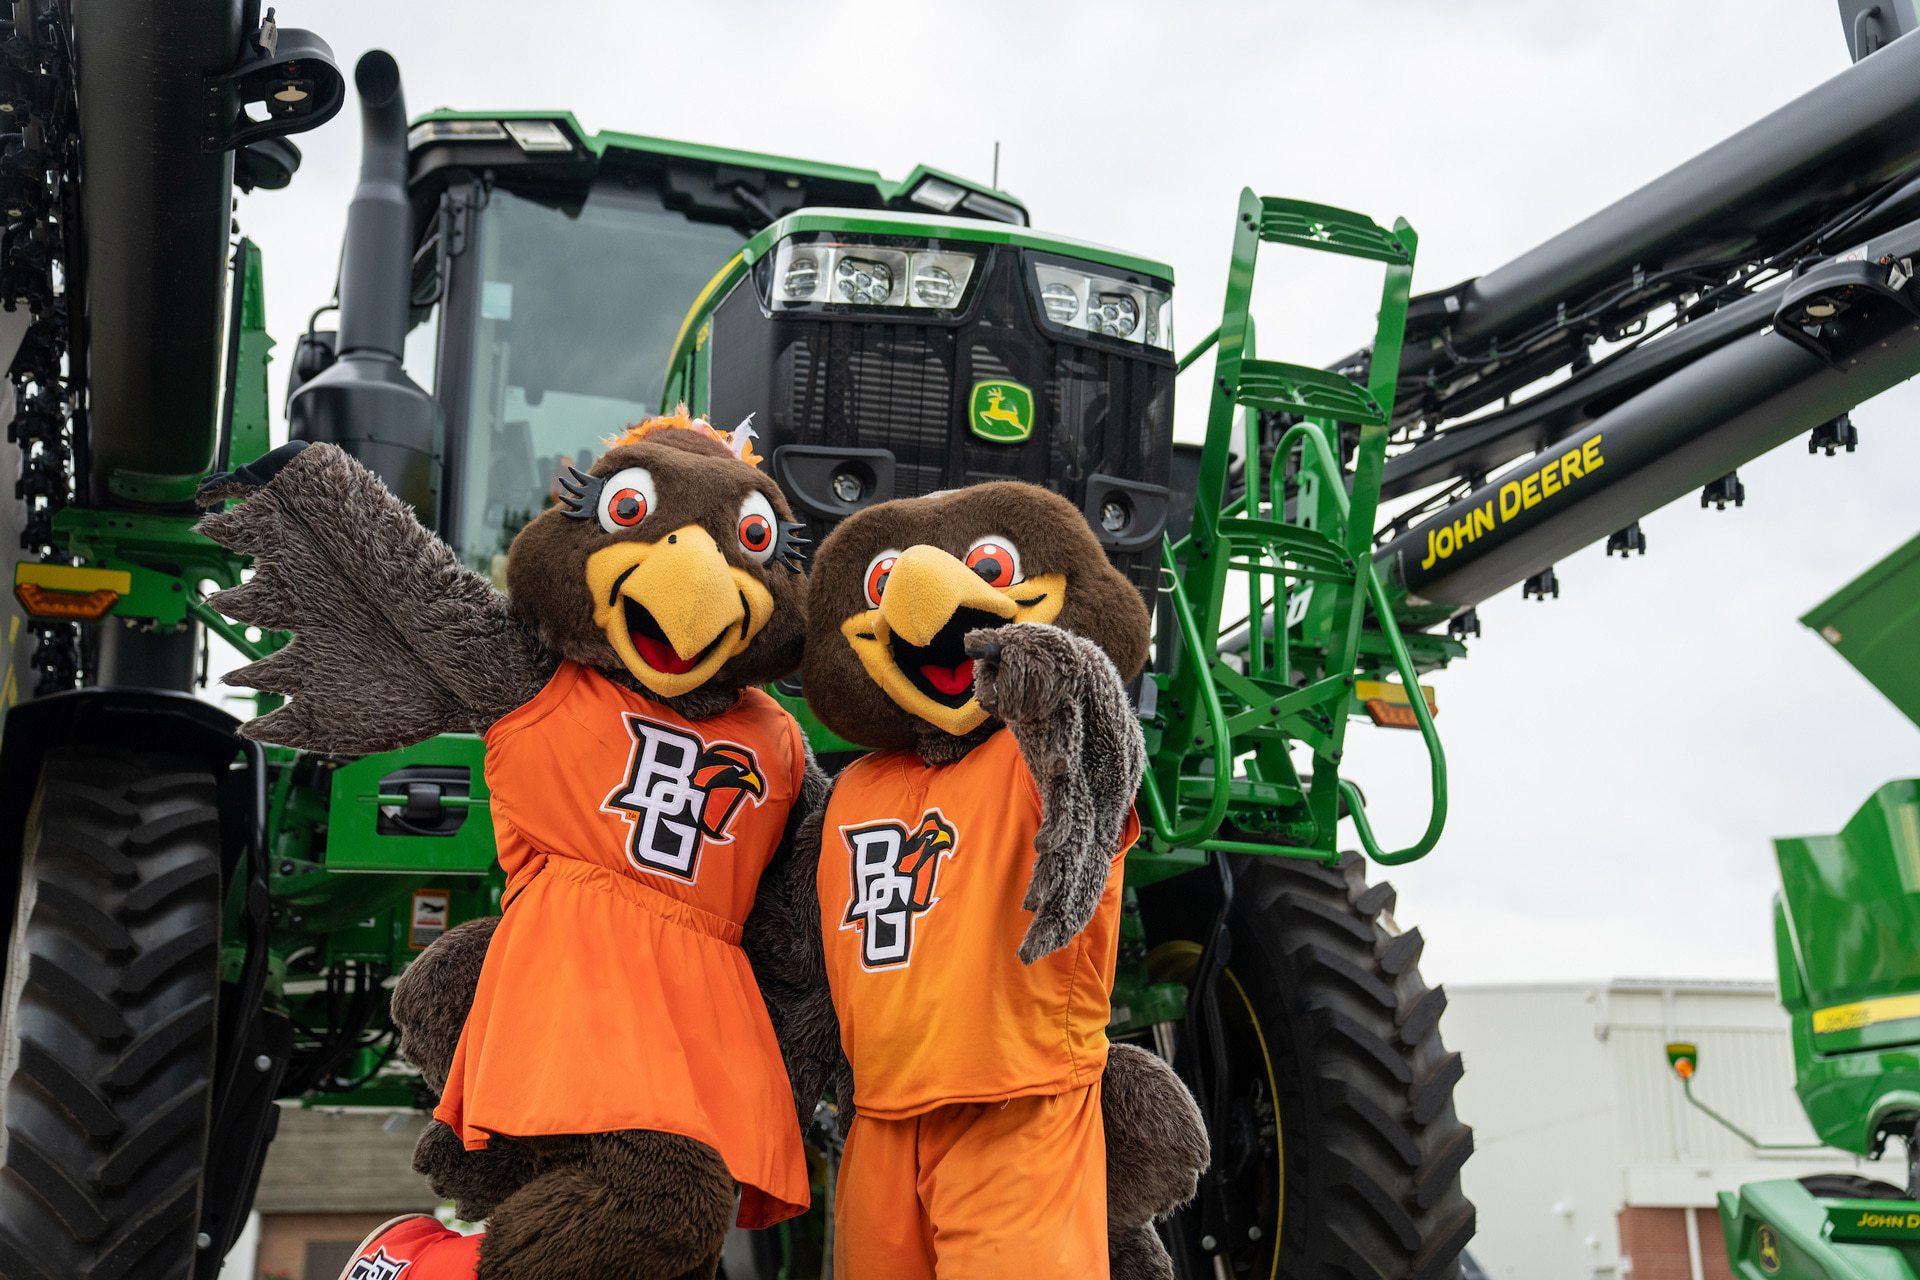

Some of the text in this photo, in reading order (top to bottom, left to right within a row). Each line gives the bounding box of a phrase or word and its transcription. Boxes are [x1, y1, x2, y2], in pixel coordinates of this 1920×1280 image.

[1421, 434, 1604, 571] JOHN DEERE
[620, 724, 706, 872] BG
[852, 829, 912, 960] BG
[1857, 1211, 1904, 1228] JOHN
